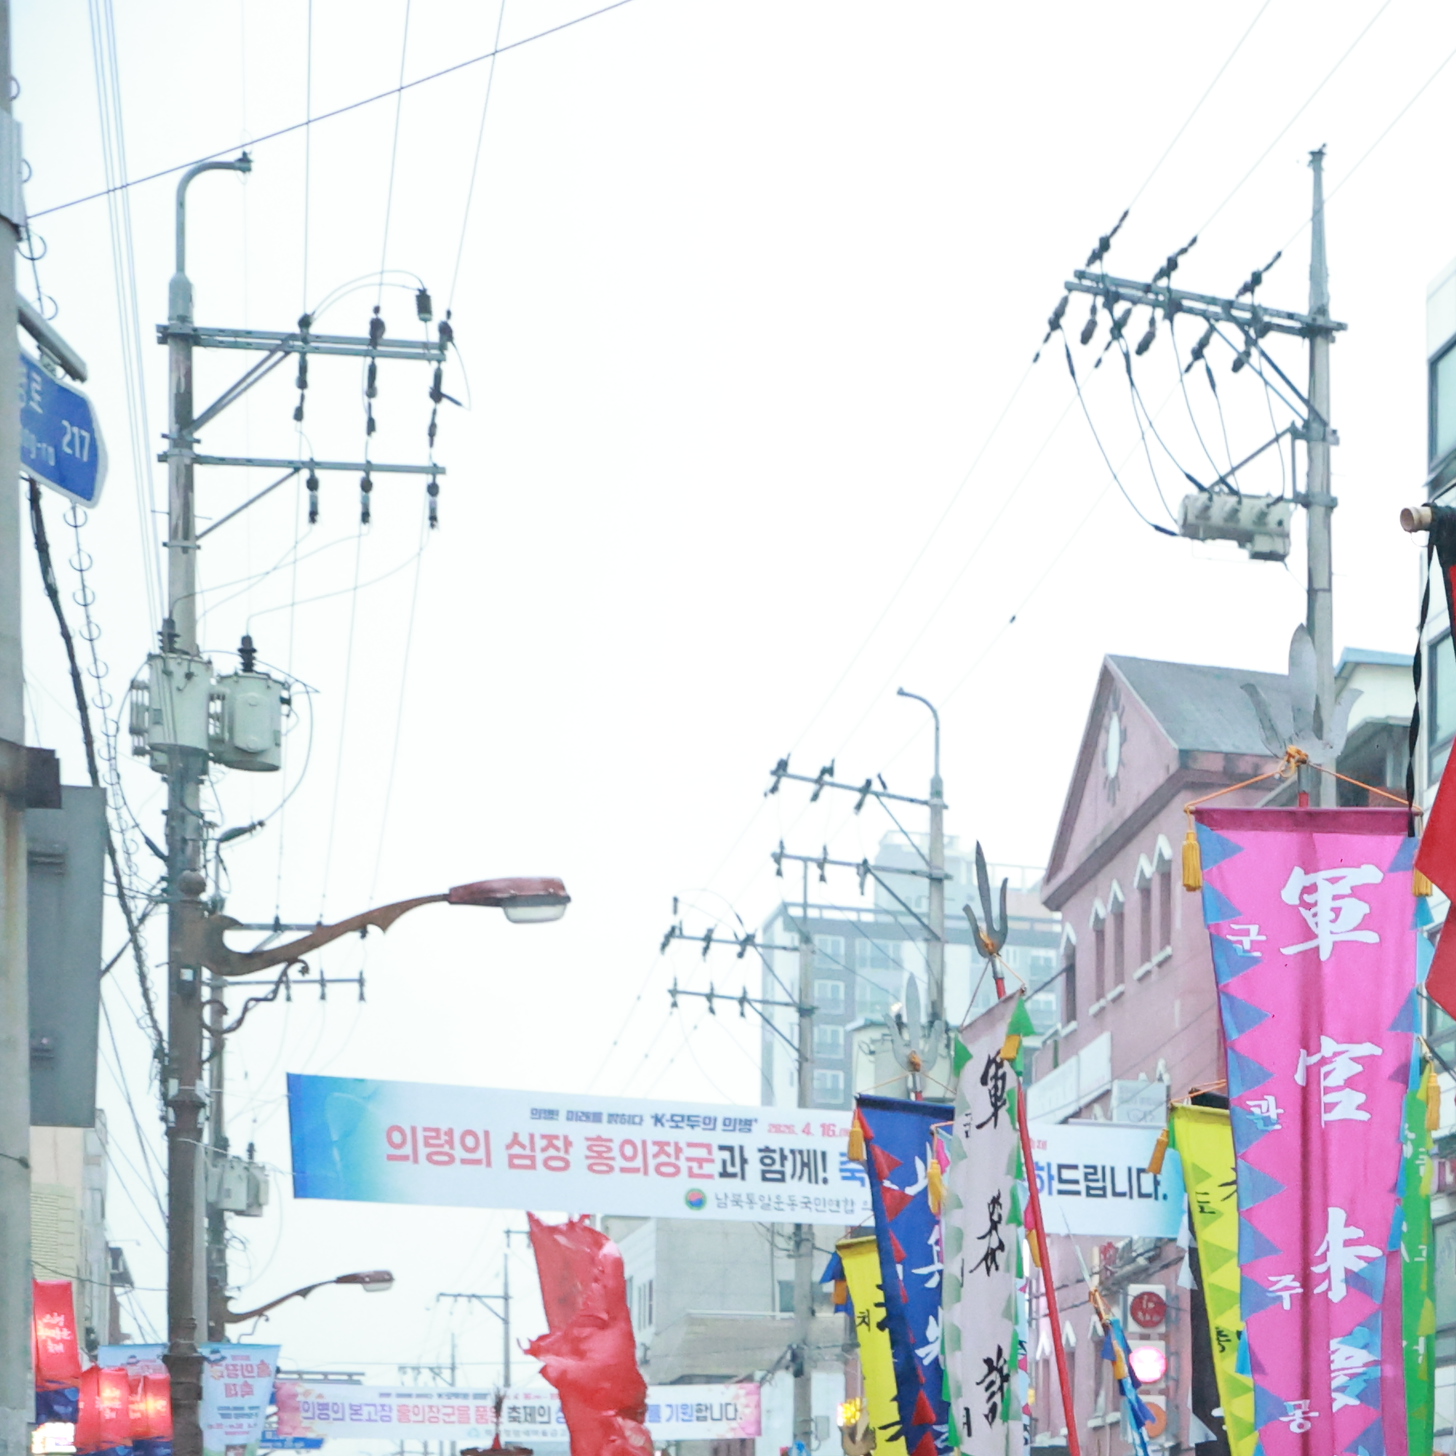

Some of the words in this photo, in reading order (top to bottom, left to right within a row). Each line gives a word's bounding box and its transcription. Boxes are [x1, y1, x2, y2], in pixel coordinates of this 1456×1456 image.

[61, 419, 91, 463] 217
[385, 1123, 493, 1169] 의령의
[504, 1131, 574, 1173] 심장
[584, 1134, 749, 1182] 홍의장군과
[757, 1144, 829, 1186] 함께!
